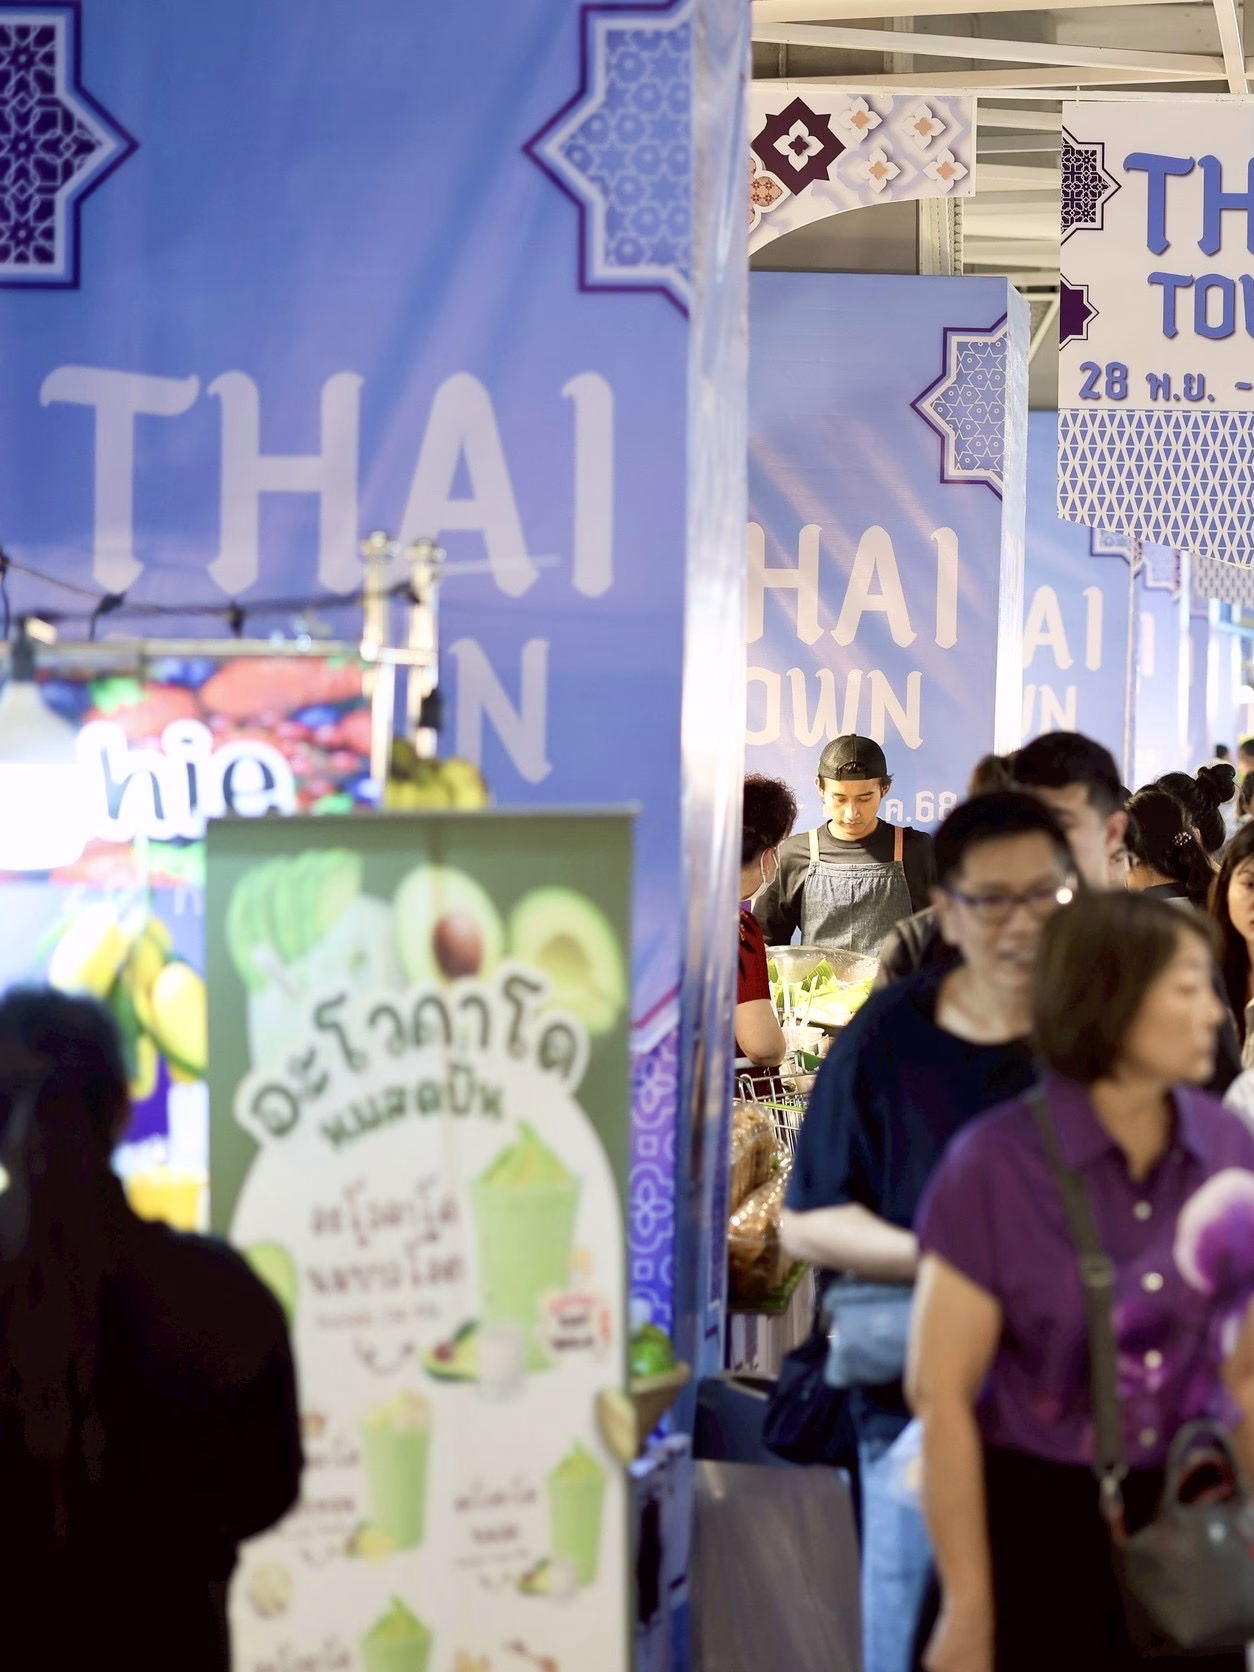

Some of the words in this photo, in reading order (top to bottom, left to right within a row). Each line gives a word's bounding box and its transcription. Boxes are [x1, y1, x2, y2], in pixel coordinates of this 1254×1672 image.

[1078, 360, 1129, 400] 28
[1145, 372, 1217, 402] พ.ย.
[40, 365, 614, 598] THAI
[747, 522, 959, 649] HAI
[1022, 585, 1104, 671] AI
[745, 666, 924, 750] OWN
[251, 971, 578, 1138] อะโวคาโด
